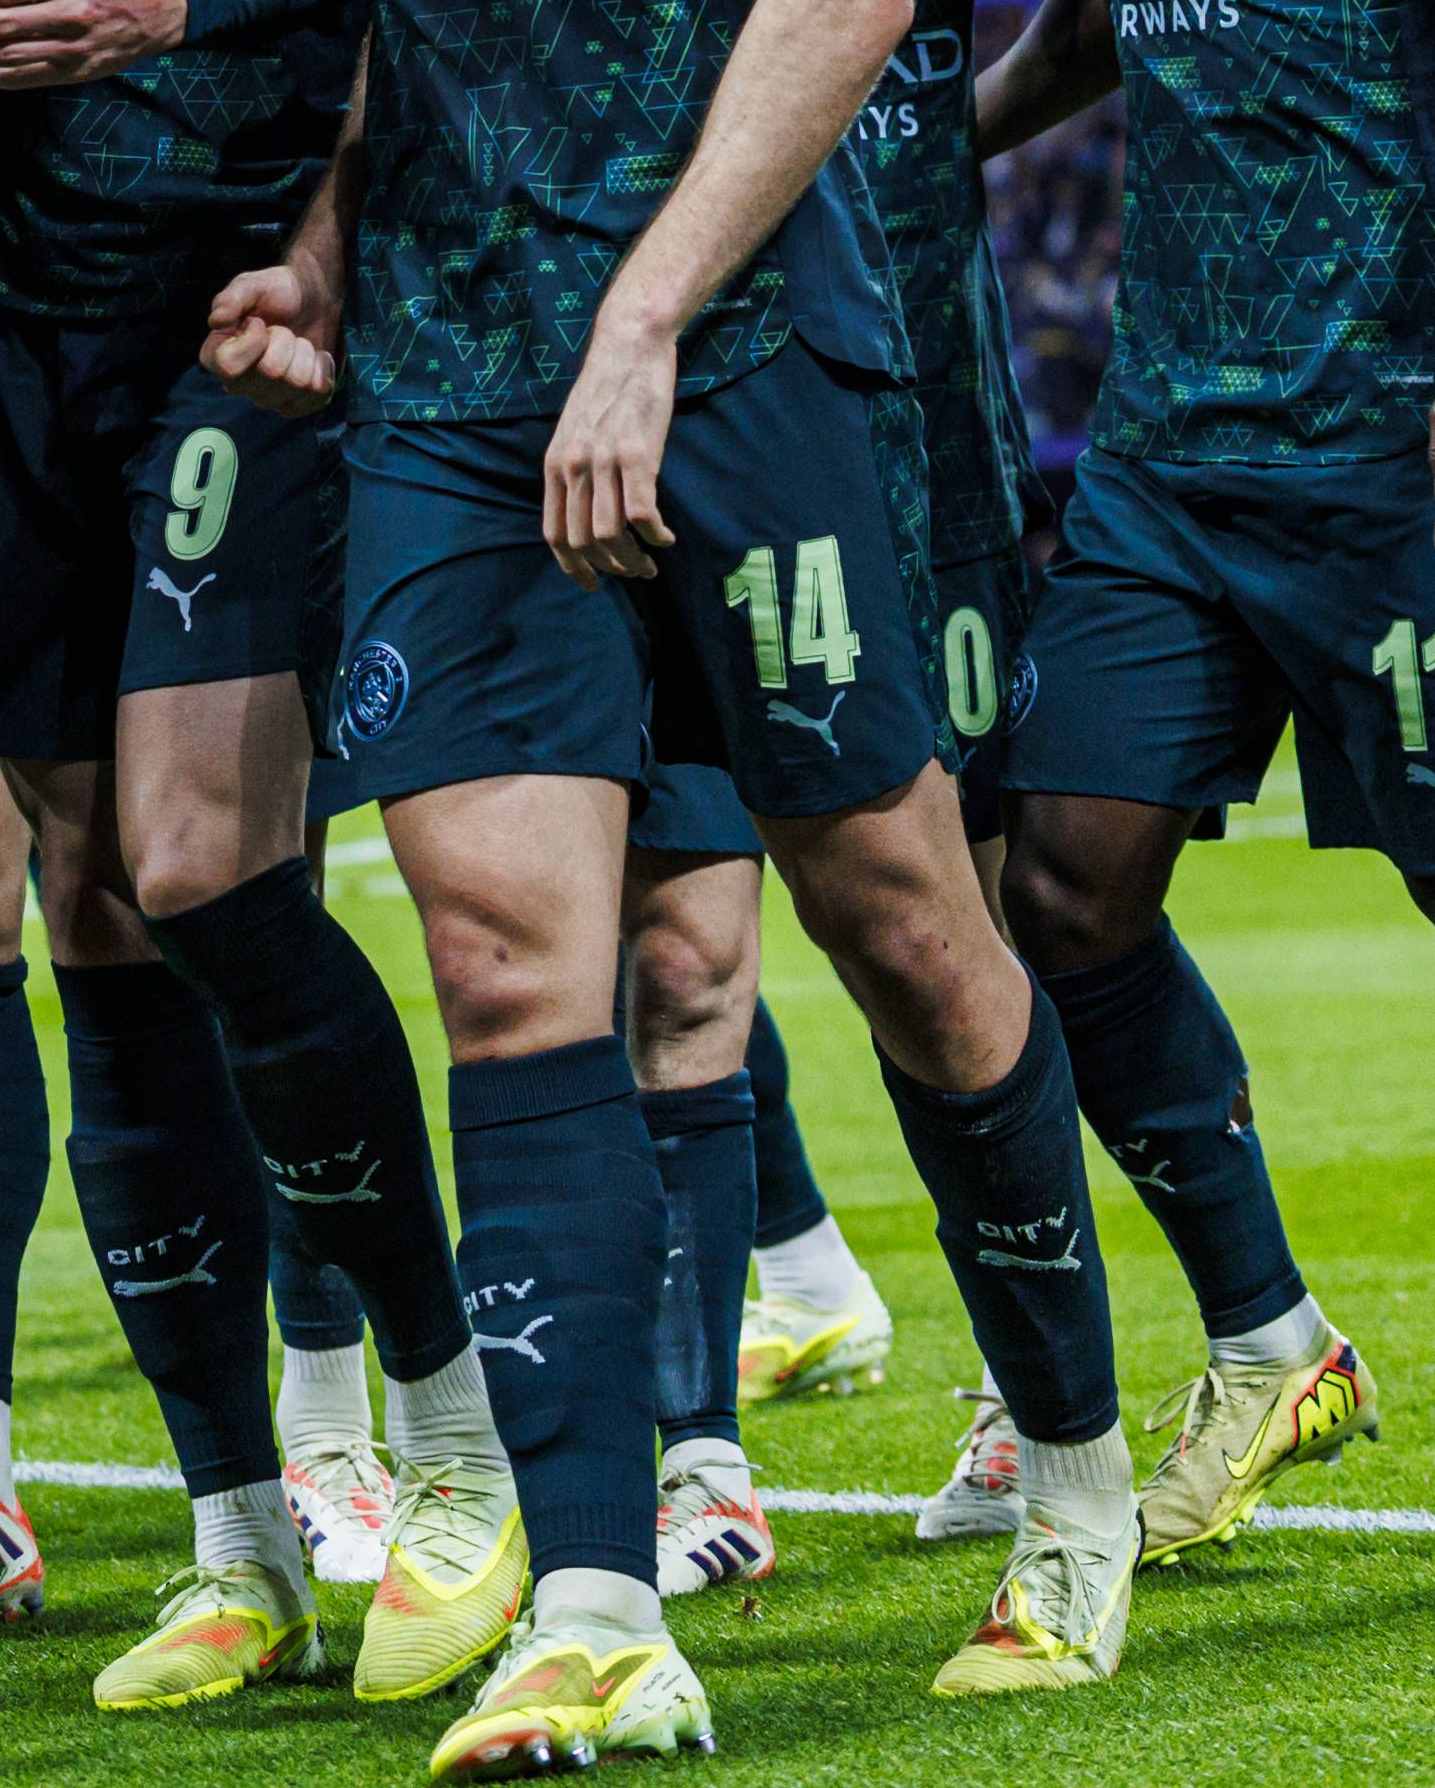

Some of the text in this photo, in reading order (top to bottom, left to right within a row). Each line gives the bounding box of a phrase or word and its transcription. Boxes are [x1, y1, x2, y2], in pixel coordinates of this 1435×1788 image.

[164, 426, 238, 561] 9
[724, 533, 862, 690] 14
[943, 606, 998, 737] 0
[463, 1277, 536, 1315] CITY
